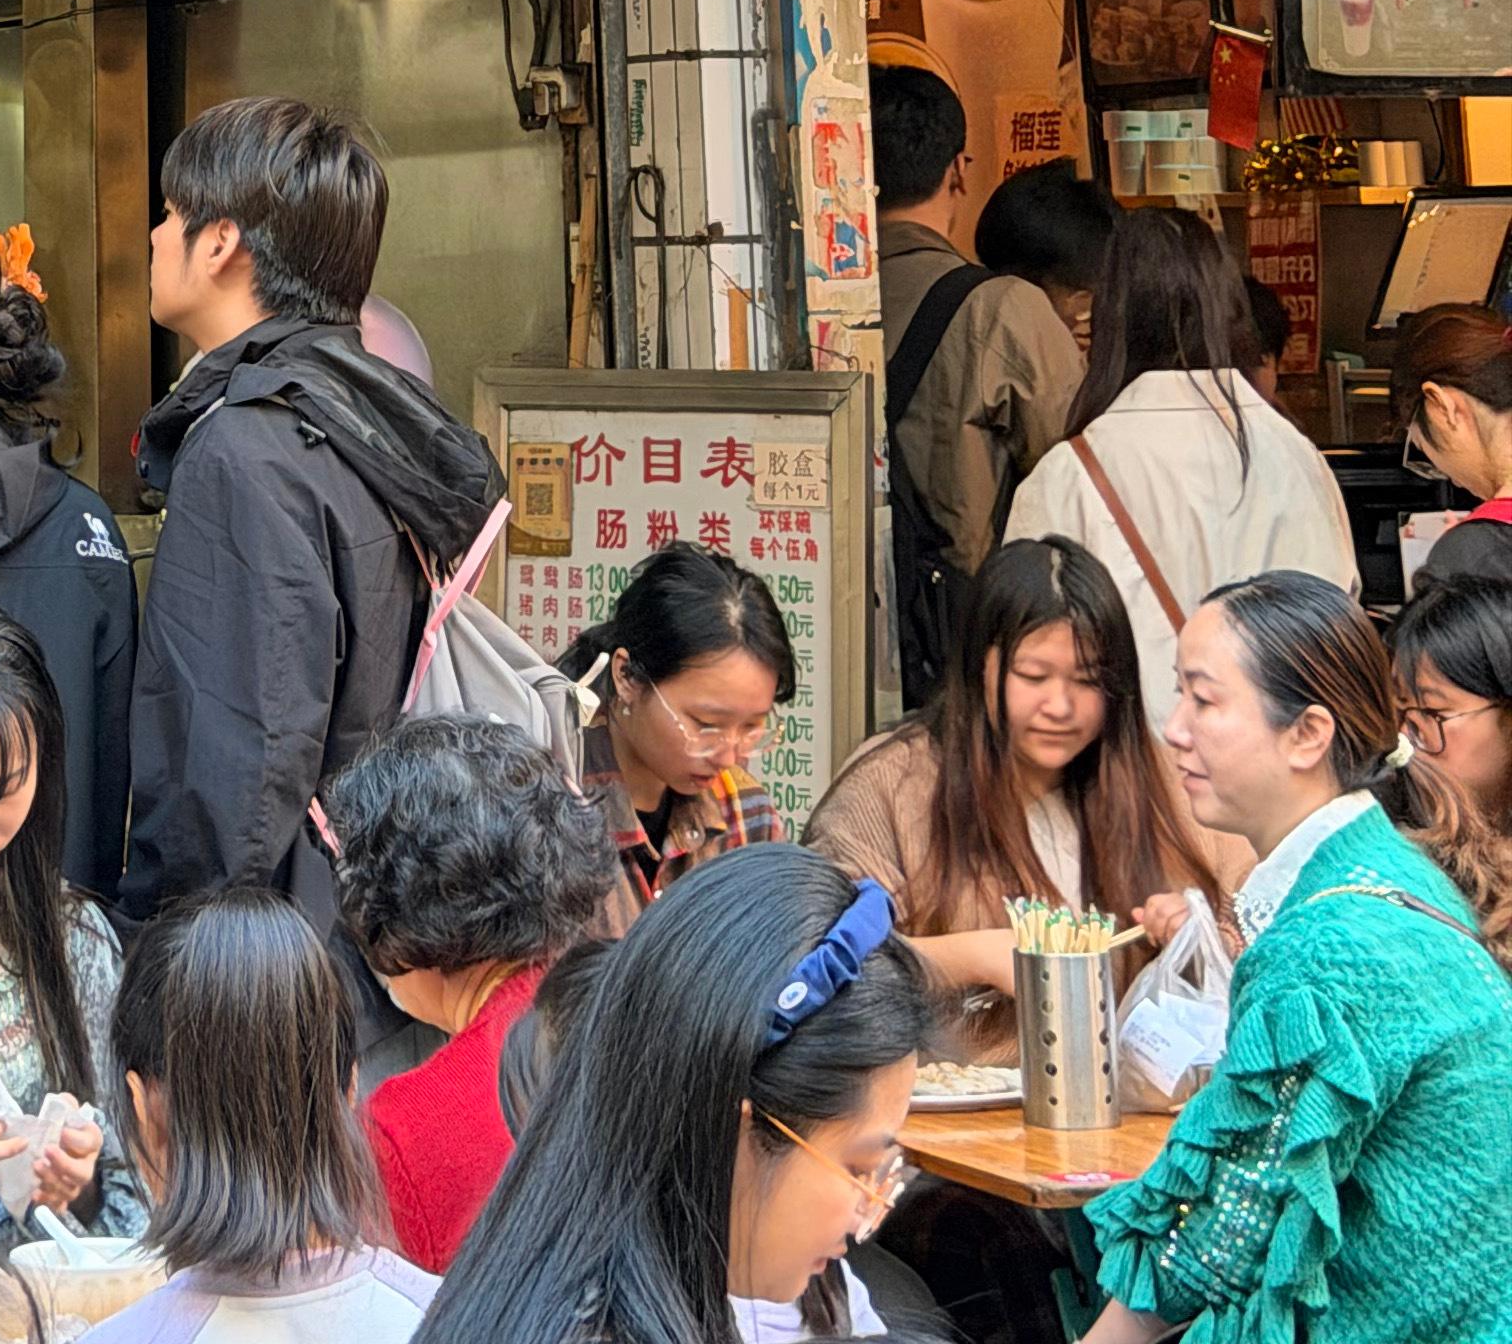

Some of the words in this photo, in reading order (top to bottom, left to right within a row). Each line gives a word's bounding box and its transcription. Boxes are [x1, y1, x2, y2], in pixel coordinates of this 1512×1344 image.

[1010, 110, 1062, 153] 榴莲
[571, 432, 754, 488] 价目表
[595, 509, 731, 556] 肠粉类
